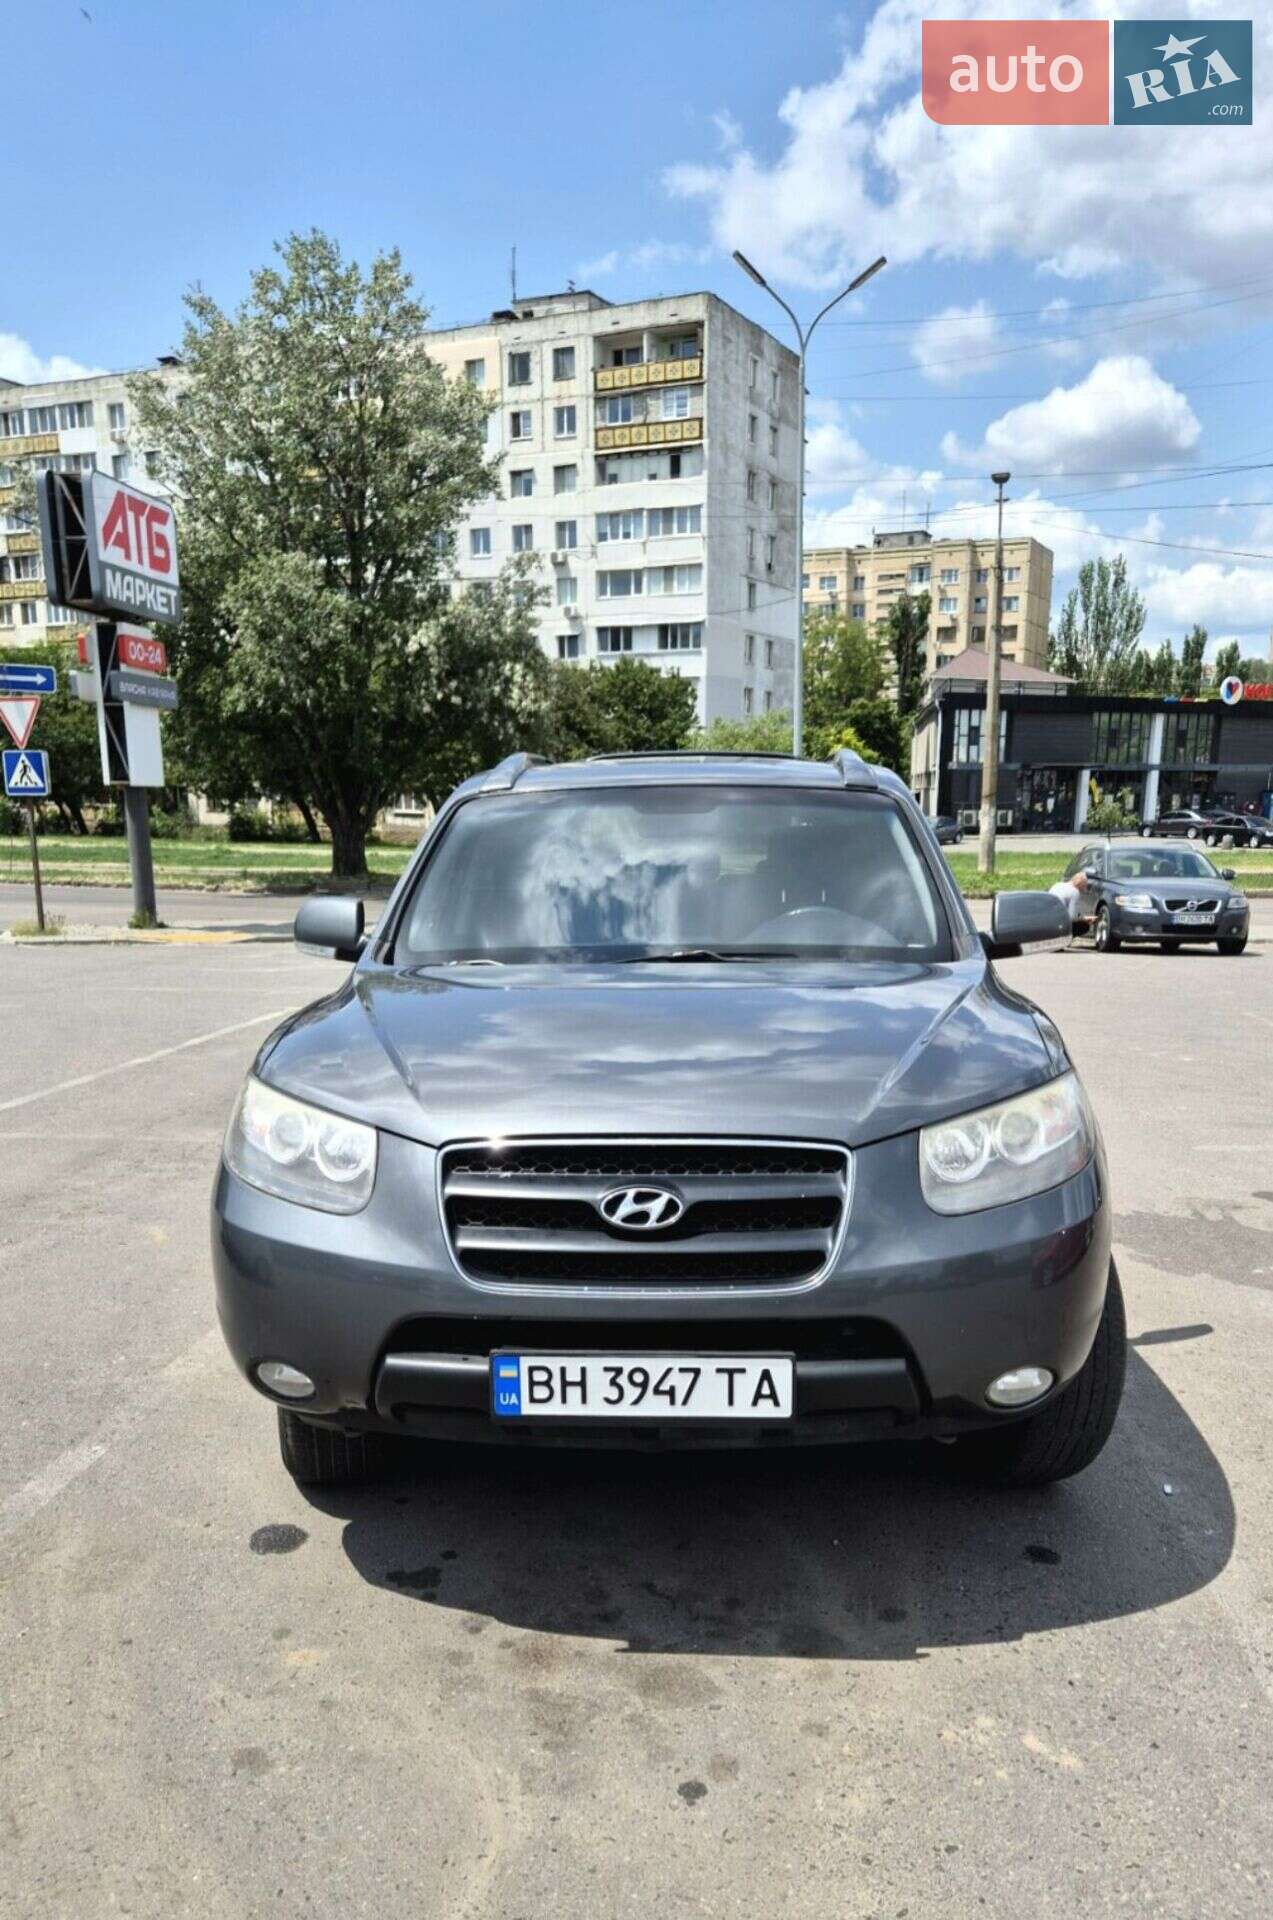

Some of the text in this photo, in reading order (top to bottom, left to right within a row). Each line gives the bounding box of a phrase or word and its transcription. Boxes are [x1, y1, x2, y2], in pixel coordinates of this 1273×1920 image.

[101, 490, 172, 575] АТБ
[104, 568, 178, 616] МАРКЕТ
[128, 641, 162, 665] 00-24
[500, 1393, 519, 1406] UA
[527, 1365, 781, 1408] BH 3947 TA
